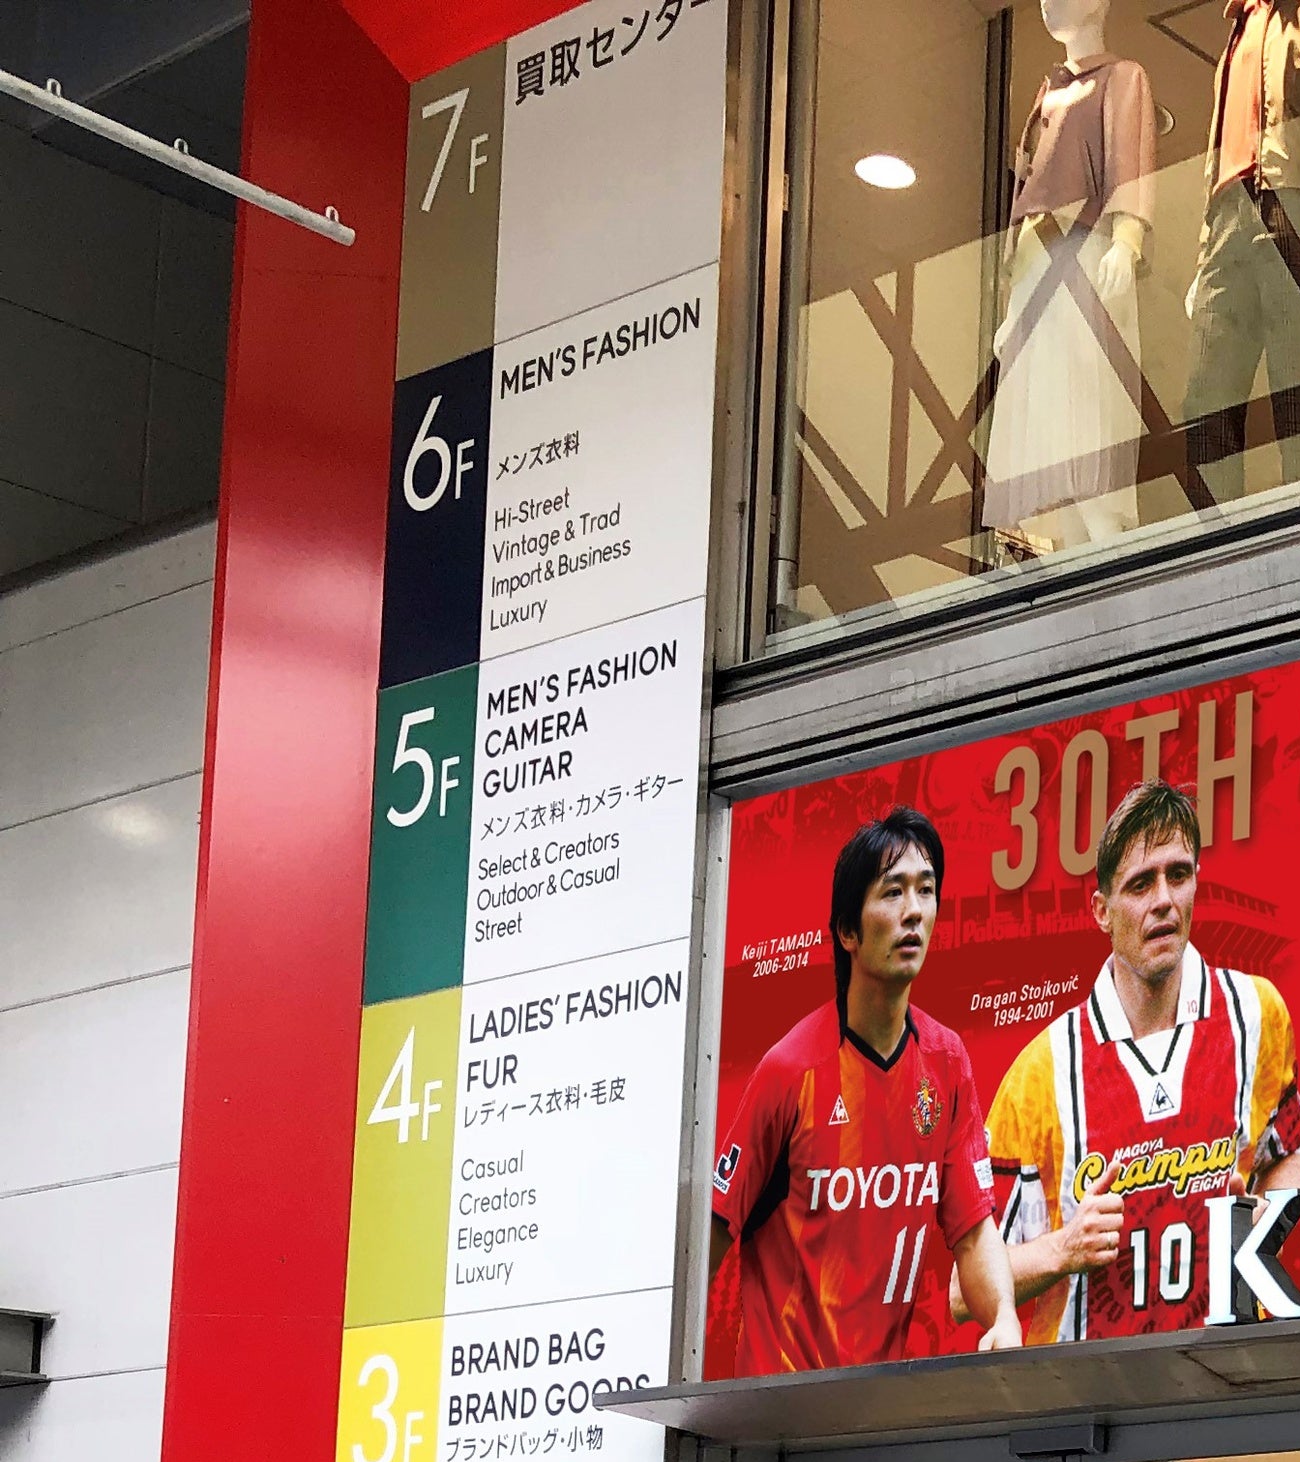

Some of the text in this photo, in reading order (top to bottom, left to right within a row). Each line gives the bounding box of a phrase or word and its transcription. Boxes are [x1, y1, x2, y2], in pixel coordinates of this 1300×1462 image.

[514, 0, 714, 106] 買取センター
[420, 87, 489, 213] 7F
[500, 298, 701, 400] MEN'S FASHION
[403, 395, 475, 512] 6F
[496, 430, 581, 480] メンズ衣料
[493, 503, 621, 564] Vintage & Trad
[494, 487, 570, 531] Hi-Street
[491, 537, 632, 598] Import & Business
[490, 599, 548, 631] Luxury
[487, 639, 678, 719] MEN'S FASHION
[485, 706, 588, 759] CAMERA
[386, 707, 460, 828] 5F
[483, 750, 574, 798] GUITAR
[991, 691, 1254, 891] 30TH
[480, 774, 685, 841] メンズ衣料・カメラ・ギター
[478, 831, 620, 881] Select & Creators
[477, 859, 620, 911] Outdoor & Casual
[475, 917, 523, 943] Street
[741, 929, 822, 961] Keiji TAMADA
[752, 952, 809, 978] 2006-2014
[566, 971, 682, 1025] FASHION
[970, 984, 1016, 1012] Dragan
[993, 1001, 1054, 1027] 1994-2001
[366, 1025, 443, 1143] 4F
[467, 1054, 518, 1092] FUR
[464, 1076, 626, 1129] レディース衣料・毛皮
[461, 1150, 524, 1181] Casual
[1112, 1137, 1164, 1162] NAGOYA
[459, 1187, 537, 1216] Creators
[806, 1161, 940, 1212] TOYOTA
[1189, 1174, 1227, 1194] EIGHT
[457, 1222, 539, 1253] Elegance
[455, 1260, 514, 1286] Luxury
[882, 1224, 928, 1304] 11
[1130, 1221, 1195, 1309] 10
[451, 1328, 606, 1377] BRAND BAG
[448, 1386, 538, 1427] BRAND
[446, 1425, 604, 1462] ブランドバッグ・小物
